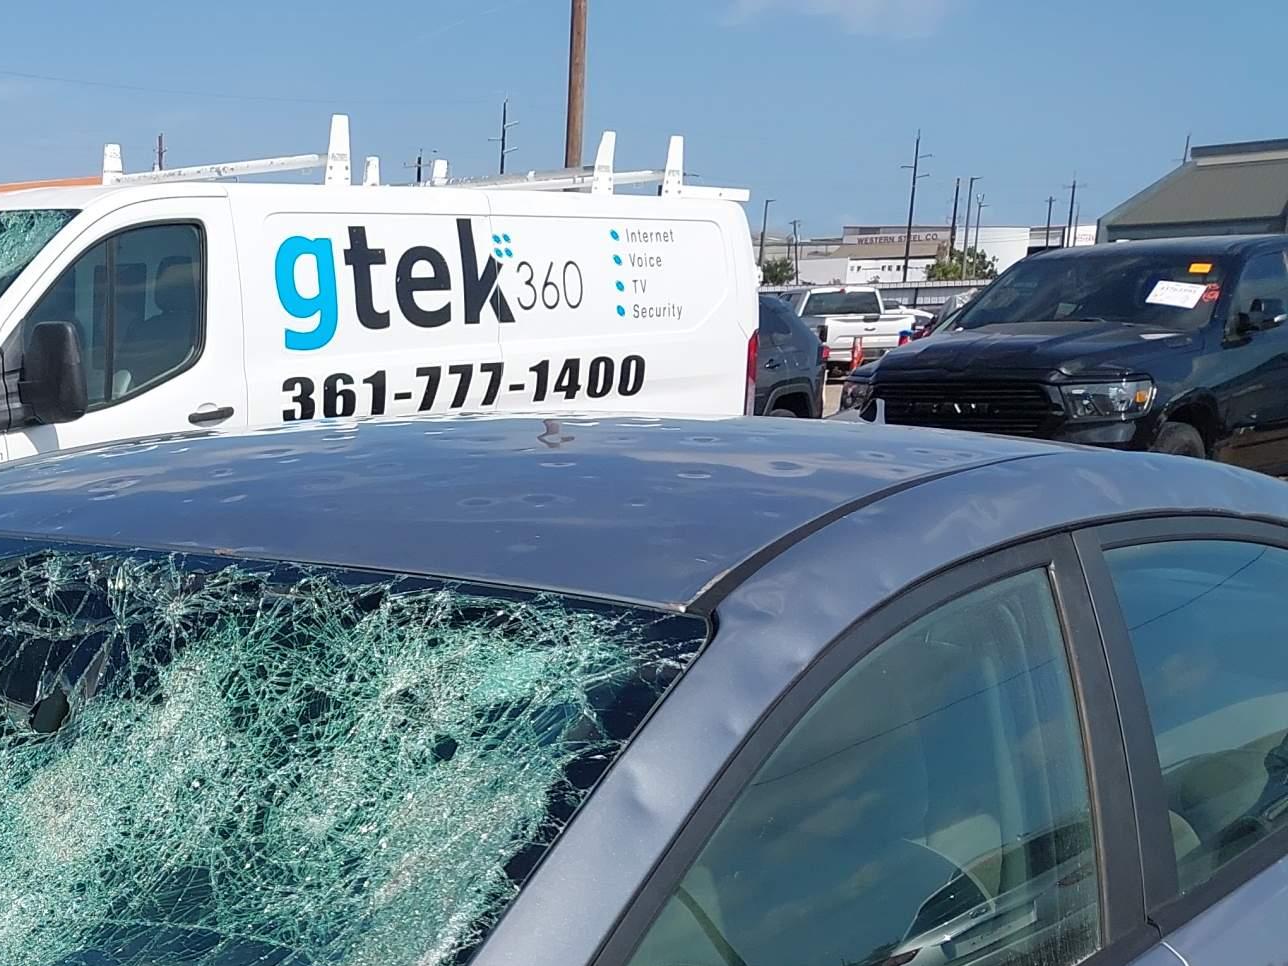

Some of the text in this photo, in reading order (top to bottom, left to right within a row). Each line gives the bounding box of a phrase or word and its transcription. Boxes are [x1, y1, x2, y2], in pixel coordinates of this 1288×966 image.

[625, 228, 675, 243] Internet
[856, 235, 895, 245] WESTERN
[628, 252, 662, 268] Voice
[632, 279, 647, 294] TV
[632, 303, 683, 321] Security
[282, 354, 646, 421] 361-777-1400
